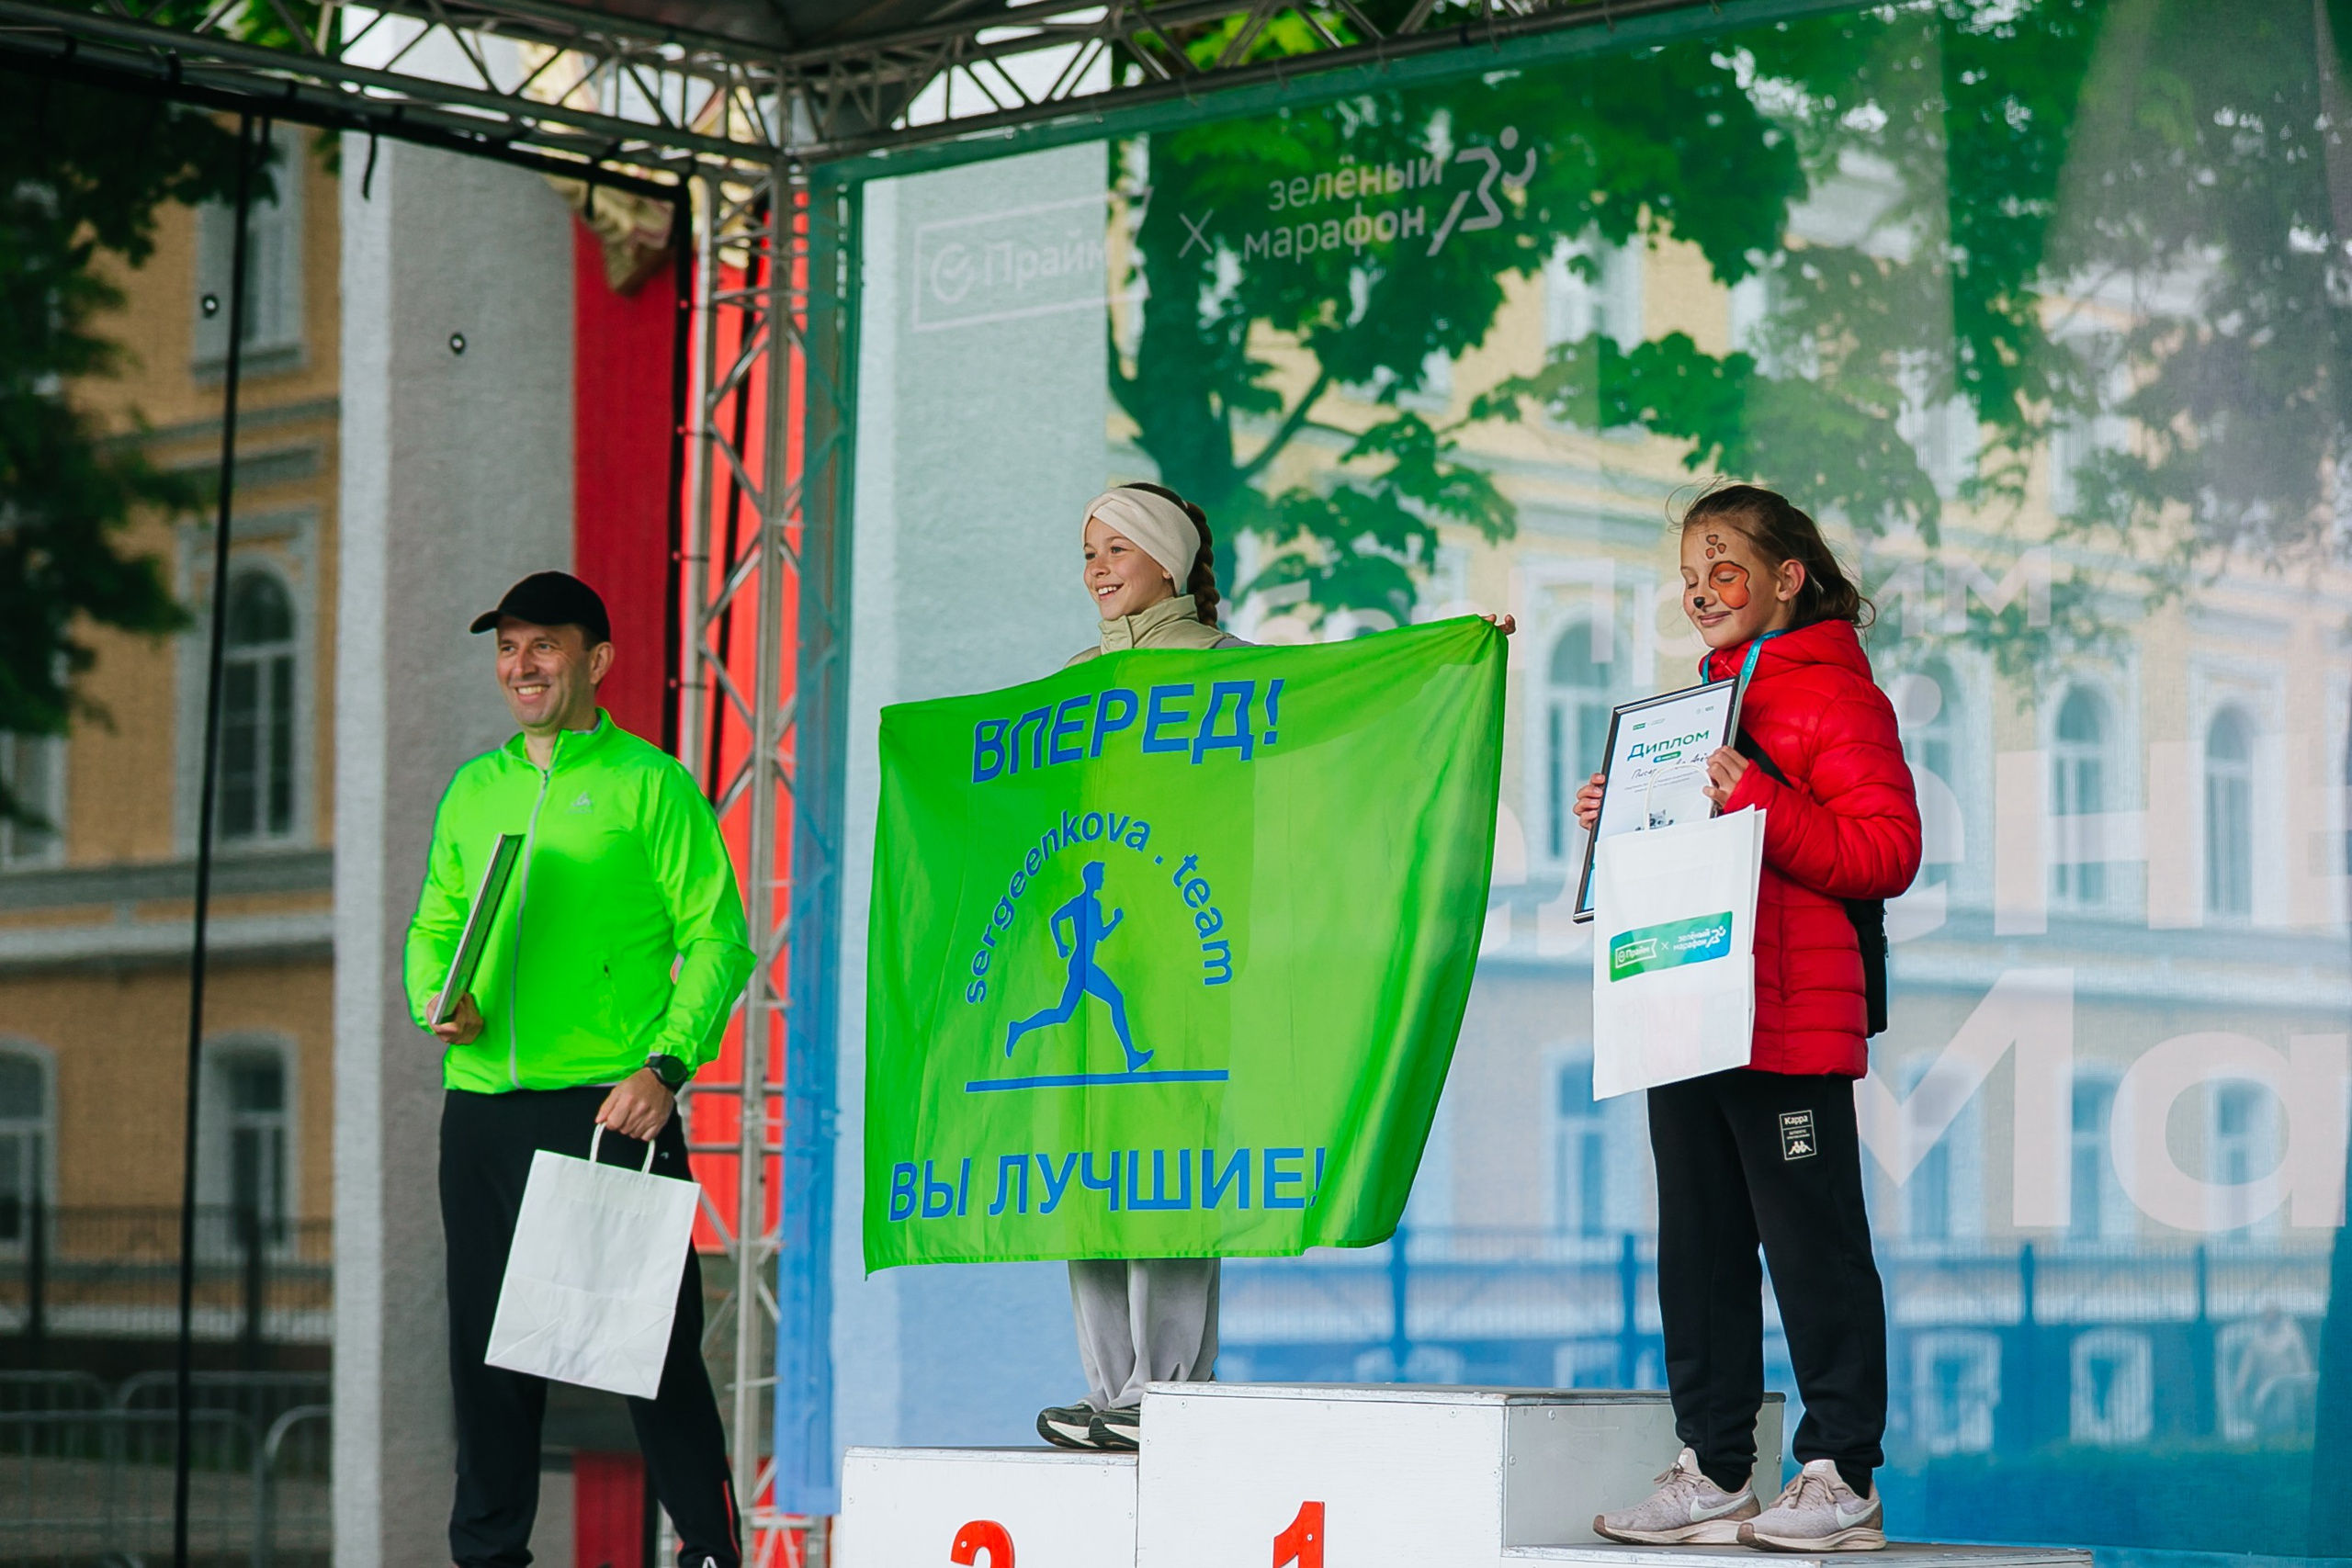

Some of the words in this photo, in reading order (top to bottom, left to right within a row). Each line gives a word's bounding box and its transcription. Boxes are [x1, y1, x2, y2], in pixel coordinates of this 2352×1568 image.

[1268, 156, 1442, 211] зелёный
[1242, 201, 1425, 264] марафон
[971, 678, 1286, 784] ВПЕРЕД!
[1626, 729, 1710, 761] Диплом
[1784, 1115, 1808, 1124] Kappa
[888, 1159, 970, 1223] ВЫ
[989, 1146, 1327, 1216] ЛУЧШИЕ!
